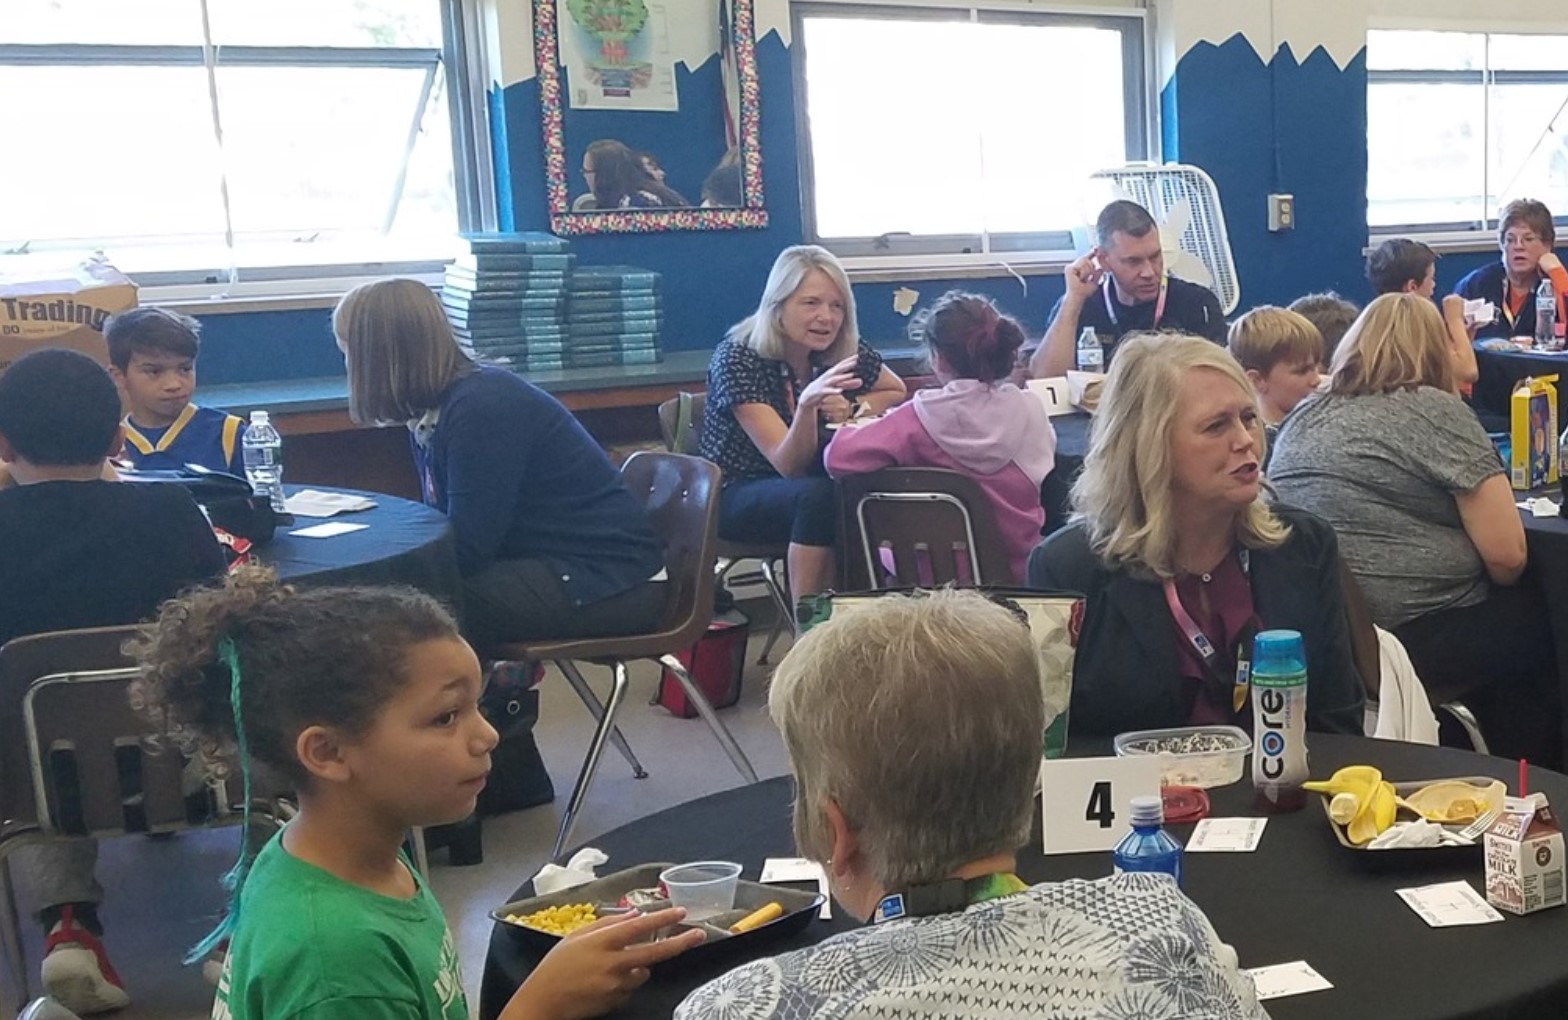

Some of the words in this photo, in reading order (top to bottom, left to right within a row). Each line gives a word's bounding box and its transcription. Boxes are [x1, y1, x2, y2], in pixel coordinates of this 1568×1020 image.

[1260, 688, 1285, 779] core
[1086, 781, 1115, 829] 4
[1488, 859, 1517, 876] MILK
